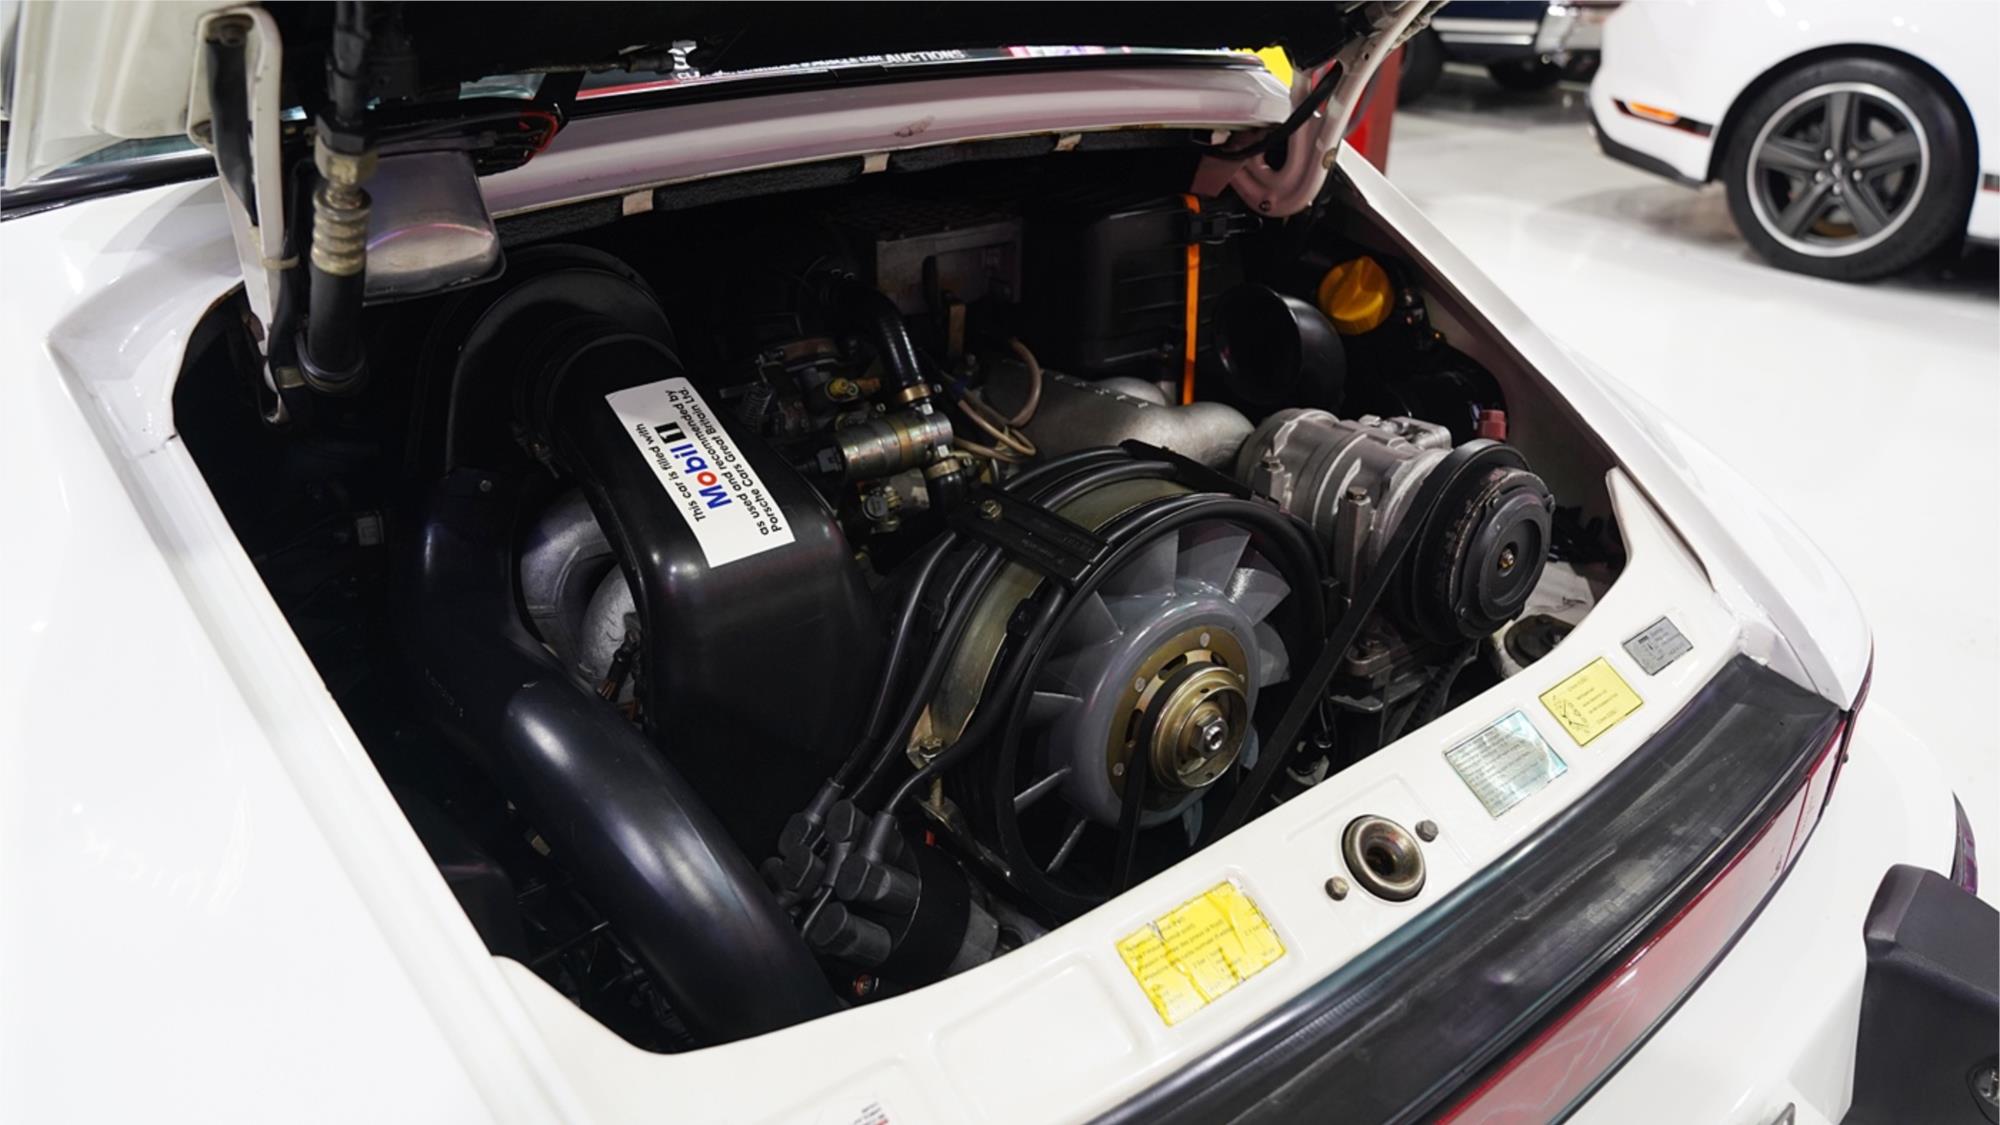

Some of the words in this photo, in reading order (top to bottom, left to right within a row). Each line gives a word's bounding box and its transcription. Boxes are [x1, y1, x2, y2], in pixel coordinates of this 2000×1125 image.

[885, 49, 966, 65] AUCTIONS
[665, 389, 680, 403] by
[677, 386, 695, 404] Ltd.
[690, 404, 717, 435] Britain
[636, 423, 654, 445] with
[654, 421, 687, 444] 1
[672, 401, 727, 470] recommended
[649, 445, 672, 471] filled
[711, 435, 736, 463] Great
[668, 471, 679, 480] is
[670, 443, 732, 509] Mobil
[721, 471, 742, 491] and
[734, 463, 754, 487] Cars
[675, 482, 692, 499] car
[689, 500, 706, 522] This
[736, 493, 760, 518] used
[751, 489, 782, 532] Porsche
[757, 520, 769, 535] as
